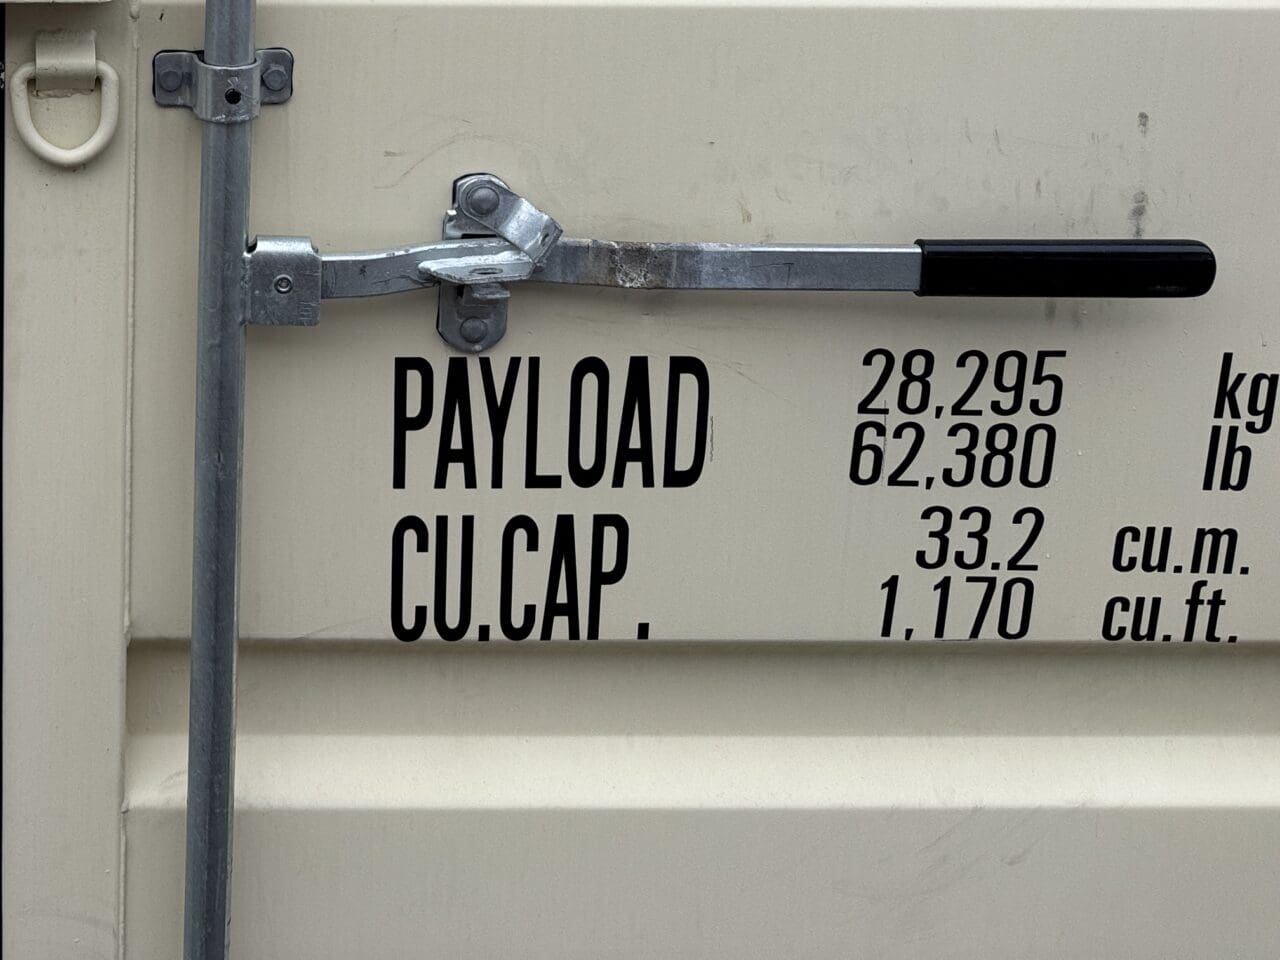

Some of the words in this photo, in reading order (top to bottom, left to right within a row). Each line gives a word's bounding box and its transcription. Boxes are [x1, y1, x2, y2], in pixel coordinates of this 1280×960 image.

[391, 355, 711, 490] PAYLOAD
[856, 348, 1068, 419] 28,295
[1210, 352, 1280, 434] kg
[848, 421, 1058, 490] 62,380
[1202, 424, 1253, 492] lb
[915, 505, 1046, 572] 33.2
[1111, 525, 1251, 576] cu.m.
[879, 574, 1036, 642] 1,170
[1100, 579, 1239, 644] cu.ft.
